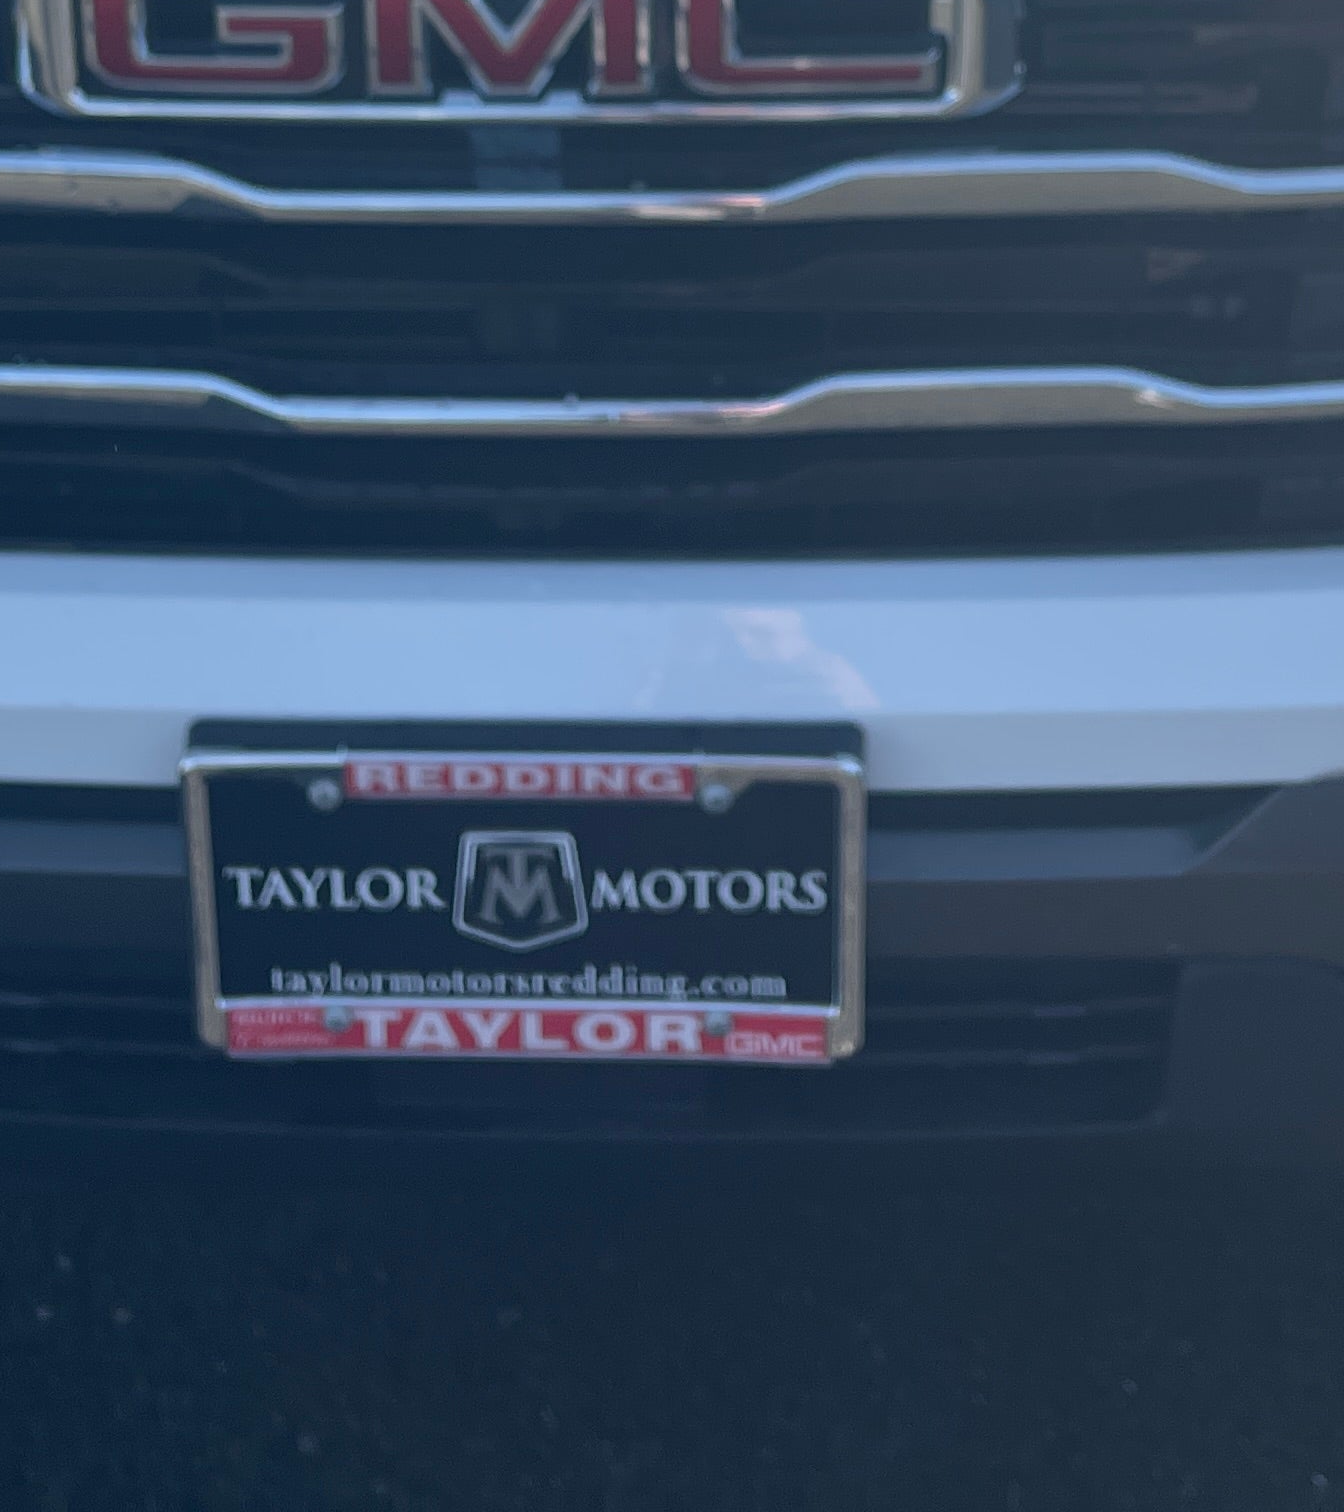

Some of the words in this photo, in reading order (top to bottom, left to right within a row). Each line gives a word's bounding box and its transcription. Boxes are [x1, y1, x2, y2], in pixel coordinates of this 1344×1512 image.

[356, 763, 684, 792] REDDING
[222, 865, 446, 910] TAYLOR
[591, 868, 827, 913] MOTORS
[271, 961, 787, 1001] taylormotorsredding.com
[356, 1009, 703, 1052] TAYLOR
[725, 1033, 818, 1057] GMC
